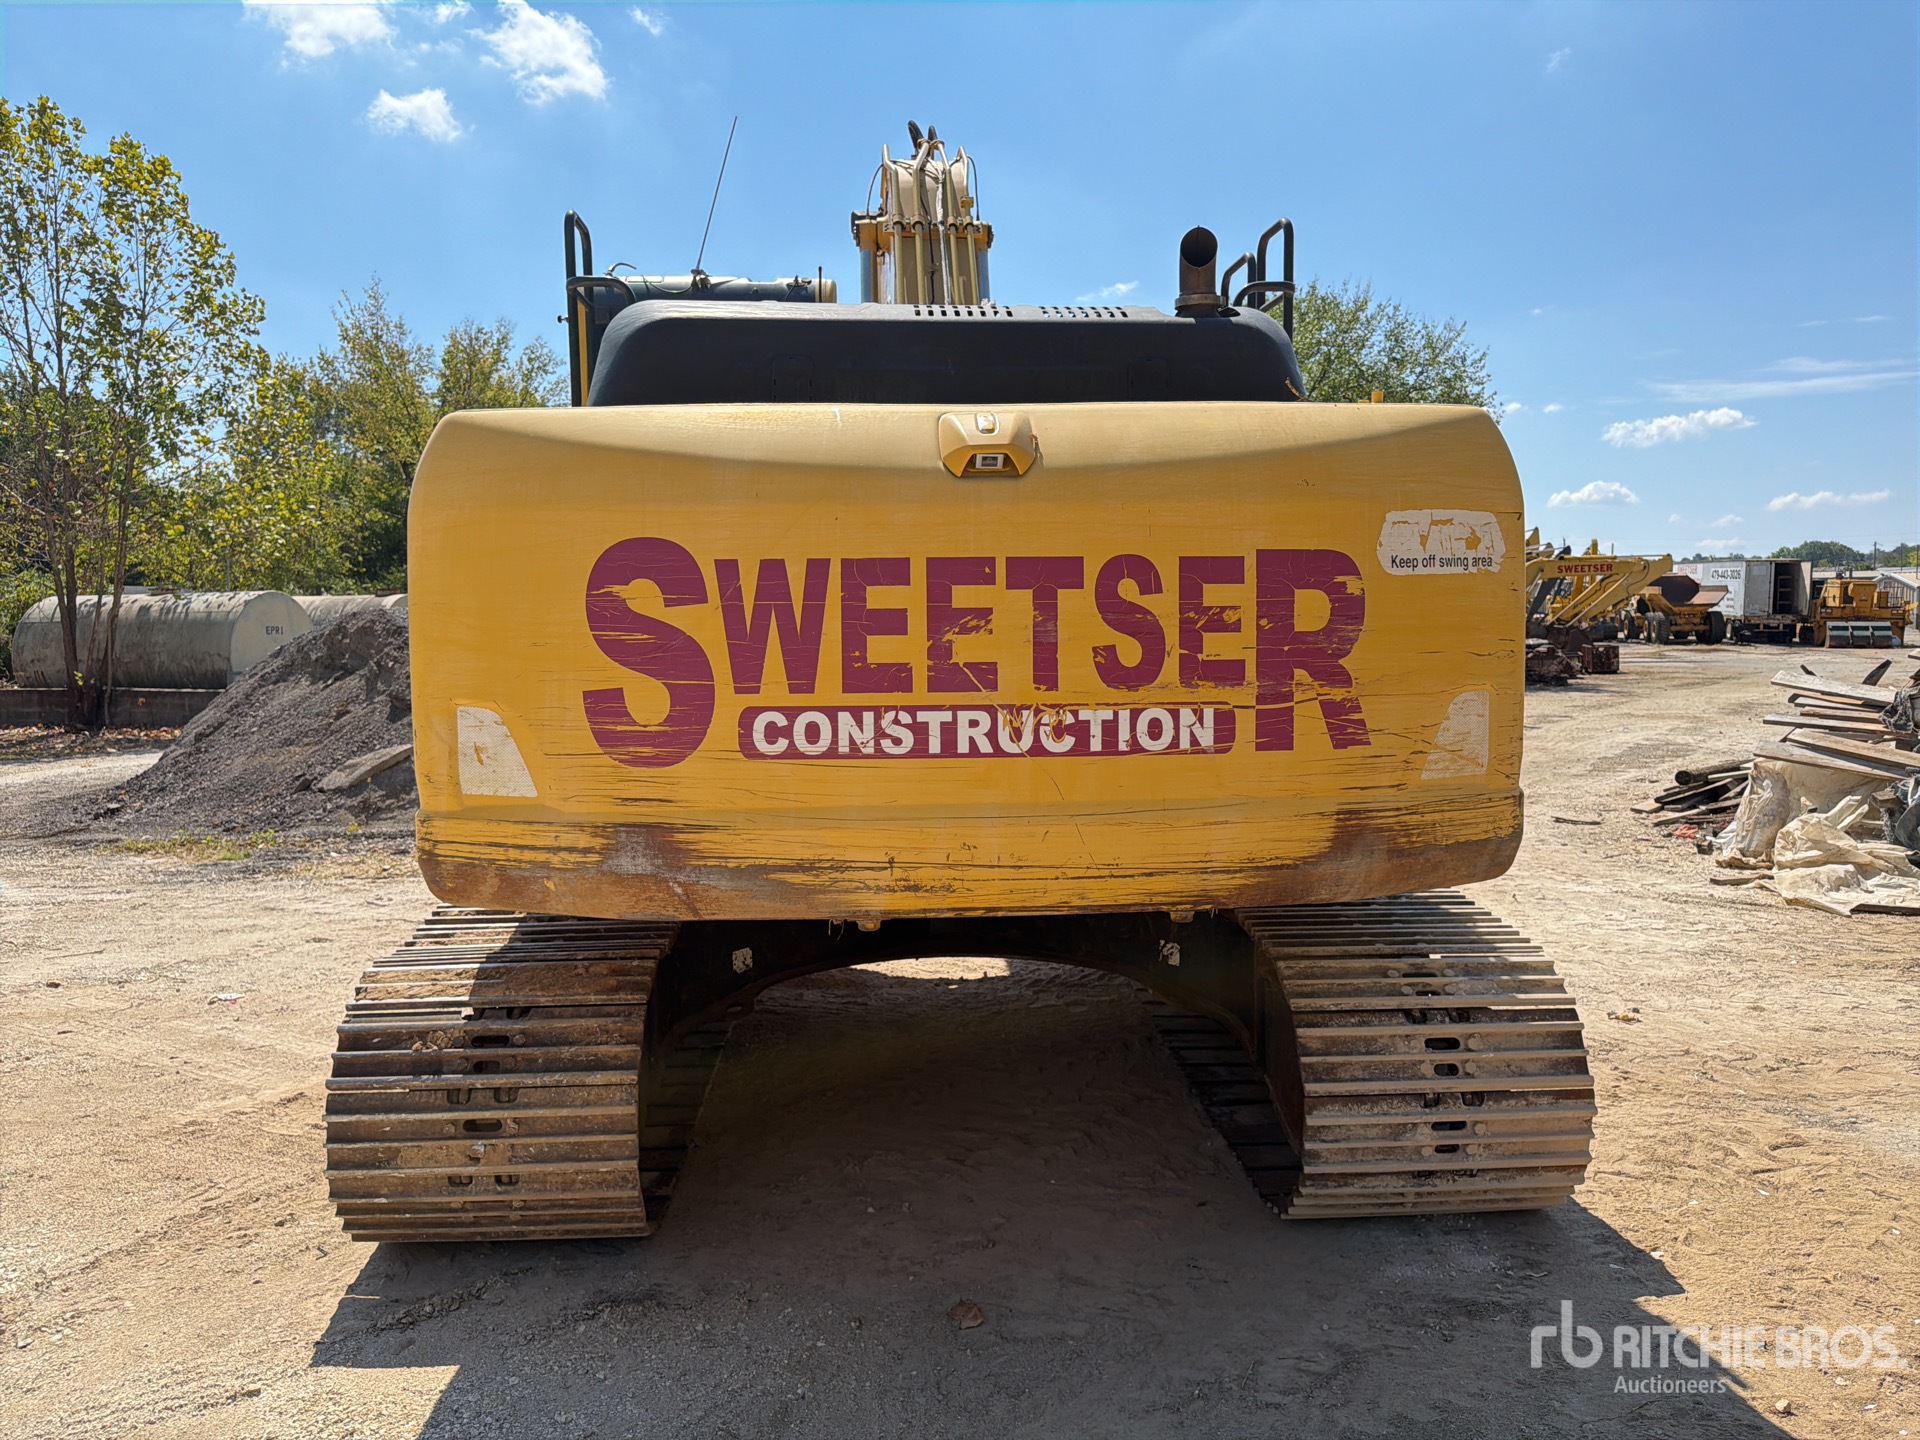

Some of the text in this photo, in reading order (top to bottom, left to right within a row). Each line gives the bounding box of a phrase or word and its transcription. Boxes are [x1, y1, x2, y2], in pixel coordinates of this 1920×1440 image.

[1391, 554, 1493, 571] Keep off swing area
[1557, 563, 1613, 574] SWEETSER
[582, 537, 1373, 768] SWEETSER
[750, 708, 1217, 756] CONSTRUCTION
